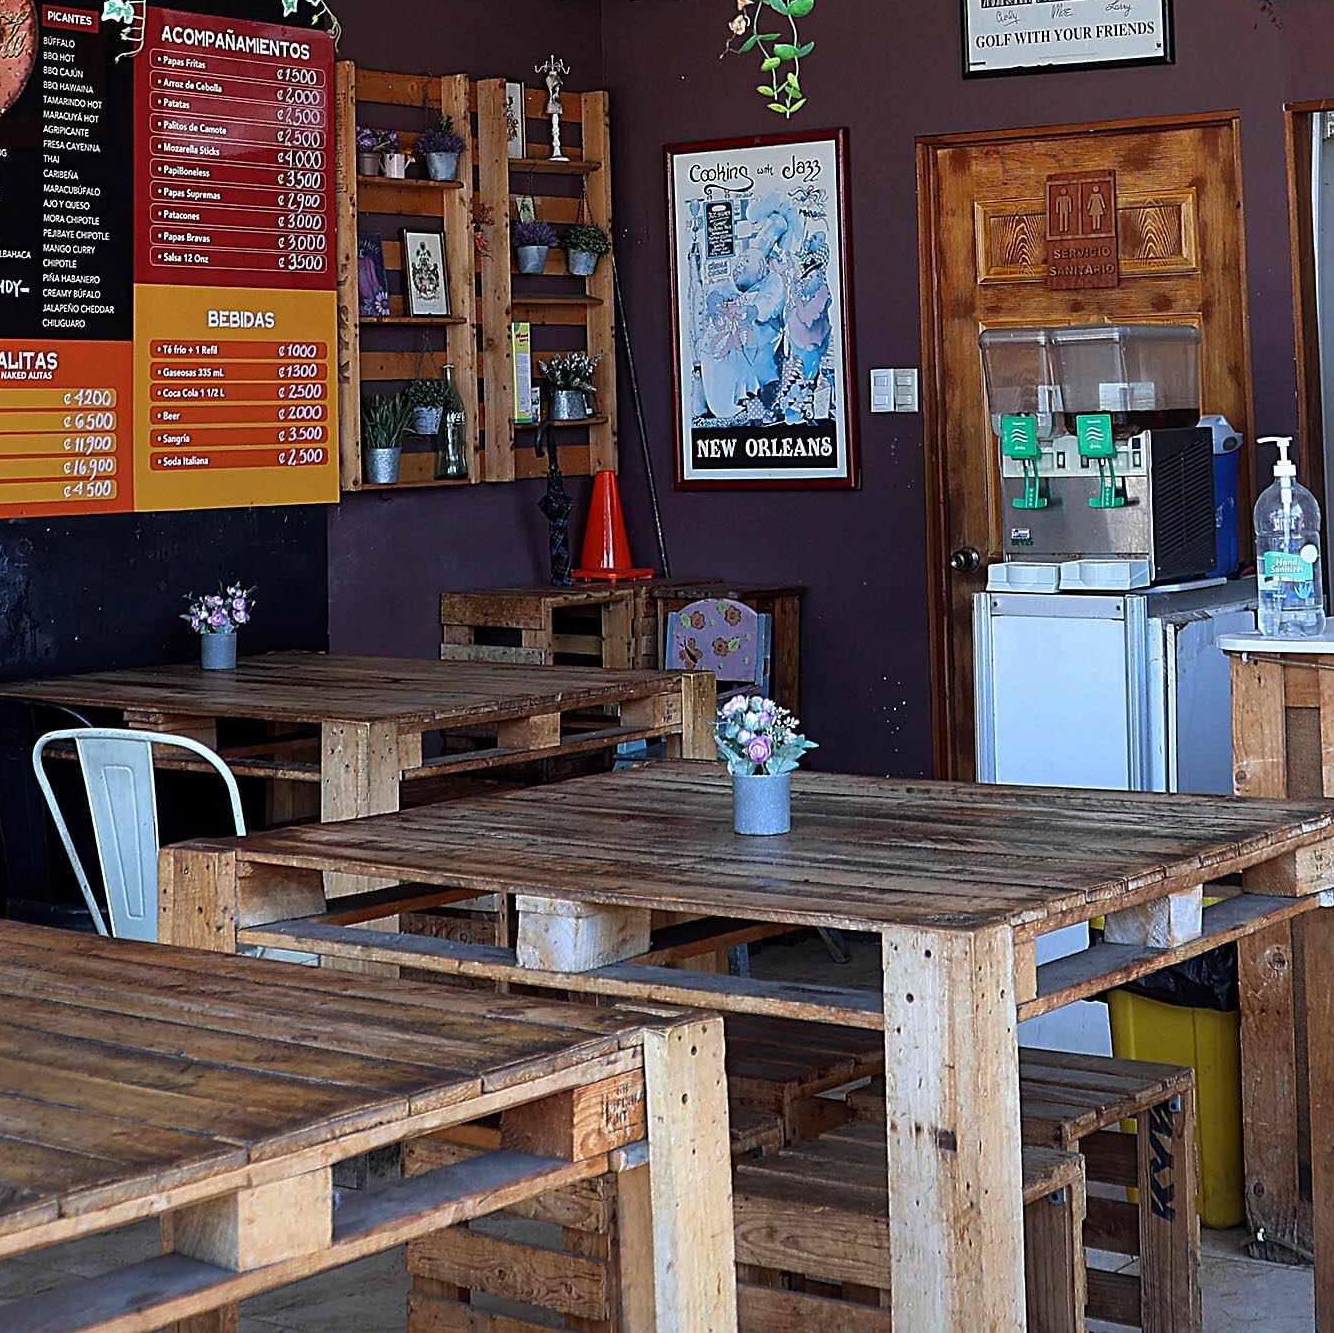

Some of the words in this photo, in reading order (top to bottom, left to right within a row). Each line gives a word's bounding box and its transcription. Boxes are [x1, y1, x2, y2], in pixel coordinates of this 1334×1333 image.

[47, 11, 92, 25] PICANTES
[976, 34, 1011, 48] GOLF
[1015, 30, 1050, 45] WITH
[1055, 27, 1091, 42] YOUR
[1096, 22, 1154, 38] FRIENDS
[162, 26, 310, 60] ACOMPAÑAMIENTOS
[43, 52, 58, 62] BBQ
[60, 53, 75, 62] HOT
[163, 56, 185, 67] Papas
[186, 59, 206, 69] Fritas
[43, 66, 58, 76] BBQ
[43, 81, 58, 90] BBQ
[163, 78, 184, 88] Arroz
[186, 81, 194, 89] de
[196, 82, 222, 93] Cebolla
[43, 96, 86, 108] TAMARINDO
[87, 99, 102, 109] HOT
[163, 99, 190, 109] Patatas
[84, 114, 99, 123] HOT
[43, 125, 89, 137] AGRIPICANTE
[163, 121, 187, 131] Palitos
[189, 123, 198, 132] de
[200, 124, 227, 135] Camote
[43, 140, 65, 150] FRESA
[66, 142, 100, 152] CAYENNA
[163, 143, 198, 154] Mozarella
[200, 146, 220, 156] Sticks
[43, 155, 59, 163] THAI
[690, 163, 754, 191] Cooking
[757, 165, 773, 176] with
[782, 156, 821, 182] Jazz
[163, 188, 185, 199] Papas
[187, 190, 221, 200] Supremas
[43, 200, 57, 208] AJO
[66, 201, 90, 210] QUESO
[43, 215, 64, 223] MORA
[66, 216, 99, 225] CHIPOTLE
[163, 210, 200, 220] Patacones
[76, 231, 109, 240] CHIPOTLE
[163, 232, 185, 242] Papas
[187, 234, 210, 243] Bravas
[43, 244, 71, 253] MANGO
[73, 246, 95, 254] CURRY
[1054, 247, 1111, 259] SERVICIO
[163, 253, 182, 262] Salsa
[184, 254, 192, 262] 12
[194, 254, 209, 263] Onz
[43, 259, 77, 268] CHIPOTLE
[1050, 265, 1115, 276] SANITARIO
[43, 274, 59, 282] PIÑA
[61, 275, 100, 284] HABANERO
[43, 289, 72, 298] CREAMY
[73, 289, 101, 298] BÚFALO
[43, 304, 79, 313] JALAPEÑO
[81, 305, 114, 314] CHEDDAR
[207, 311, 275, 328] BEBIDAS
[163, 368, 196, 377] Gaseosas
[163, 389, 181, 397] Coca
[183, 389, 198, 397] Cola
[163, 412, 180, 420] Beer
[163, 435, 190, 445] Sangría
[697, 439, 737, 457] NEW
[745, 437, 832, 457] ORLEANS
[163, 457, 182, 466] Soda
[183, 457, 209, 465] Italiana
[1270, 565, 1305, 574] Sanitizer
